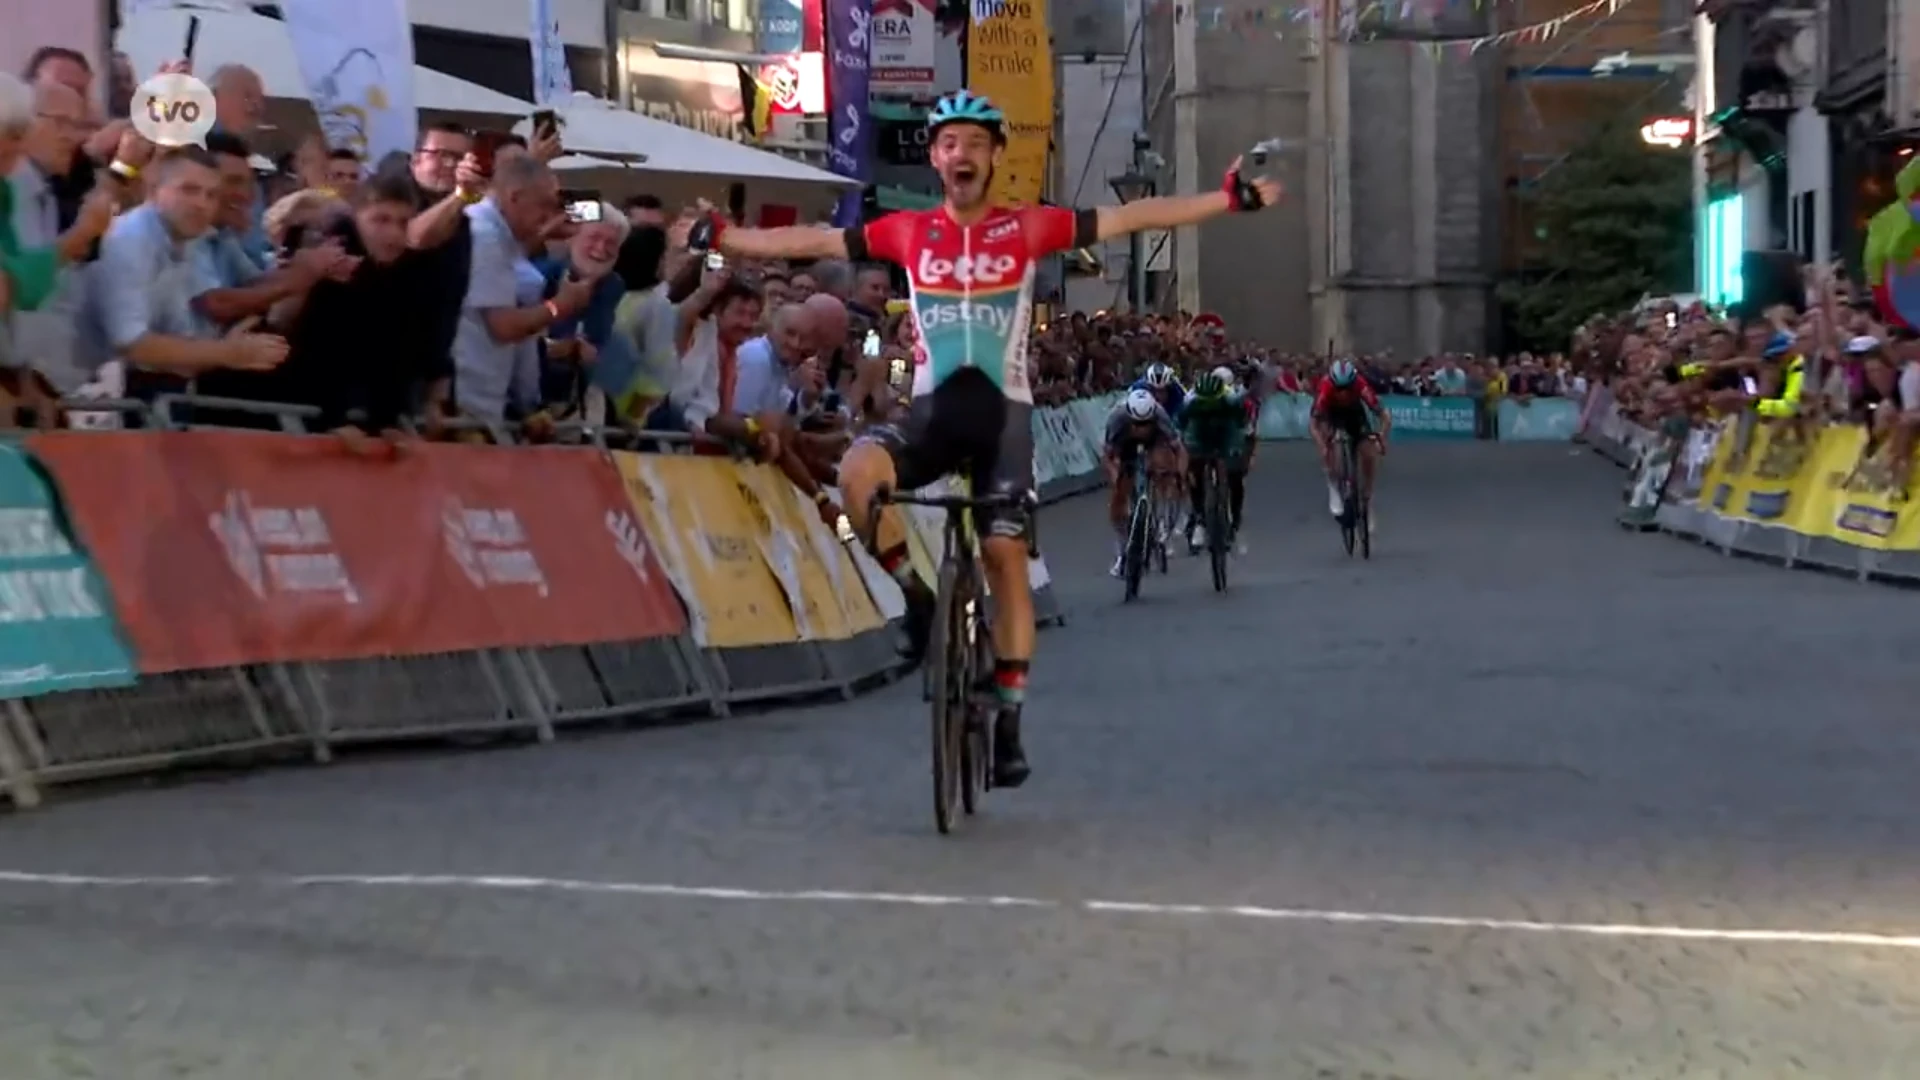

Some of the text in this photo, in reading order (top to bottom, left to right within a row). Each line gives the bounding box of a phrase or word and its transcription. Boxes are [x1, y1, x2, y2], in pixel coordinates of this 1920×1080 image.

[976, 0, 1032, 18] move
[873, 19, 911, 35] ERA
[977, 21, 1038, 47] with a
[979, 50, 1034, 74] smile
[918, 248, 1016, 284] lotto
[921, 300, 1013, 338] dstny
